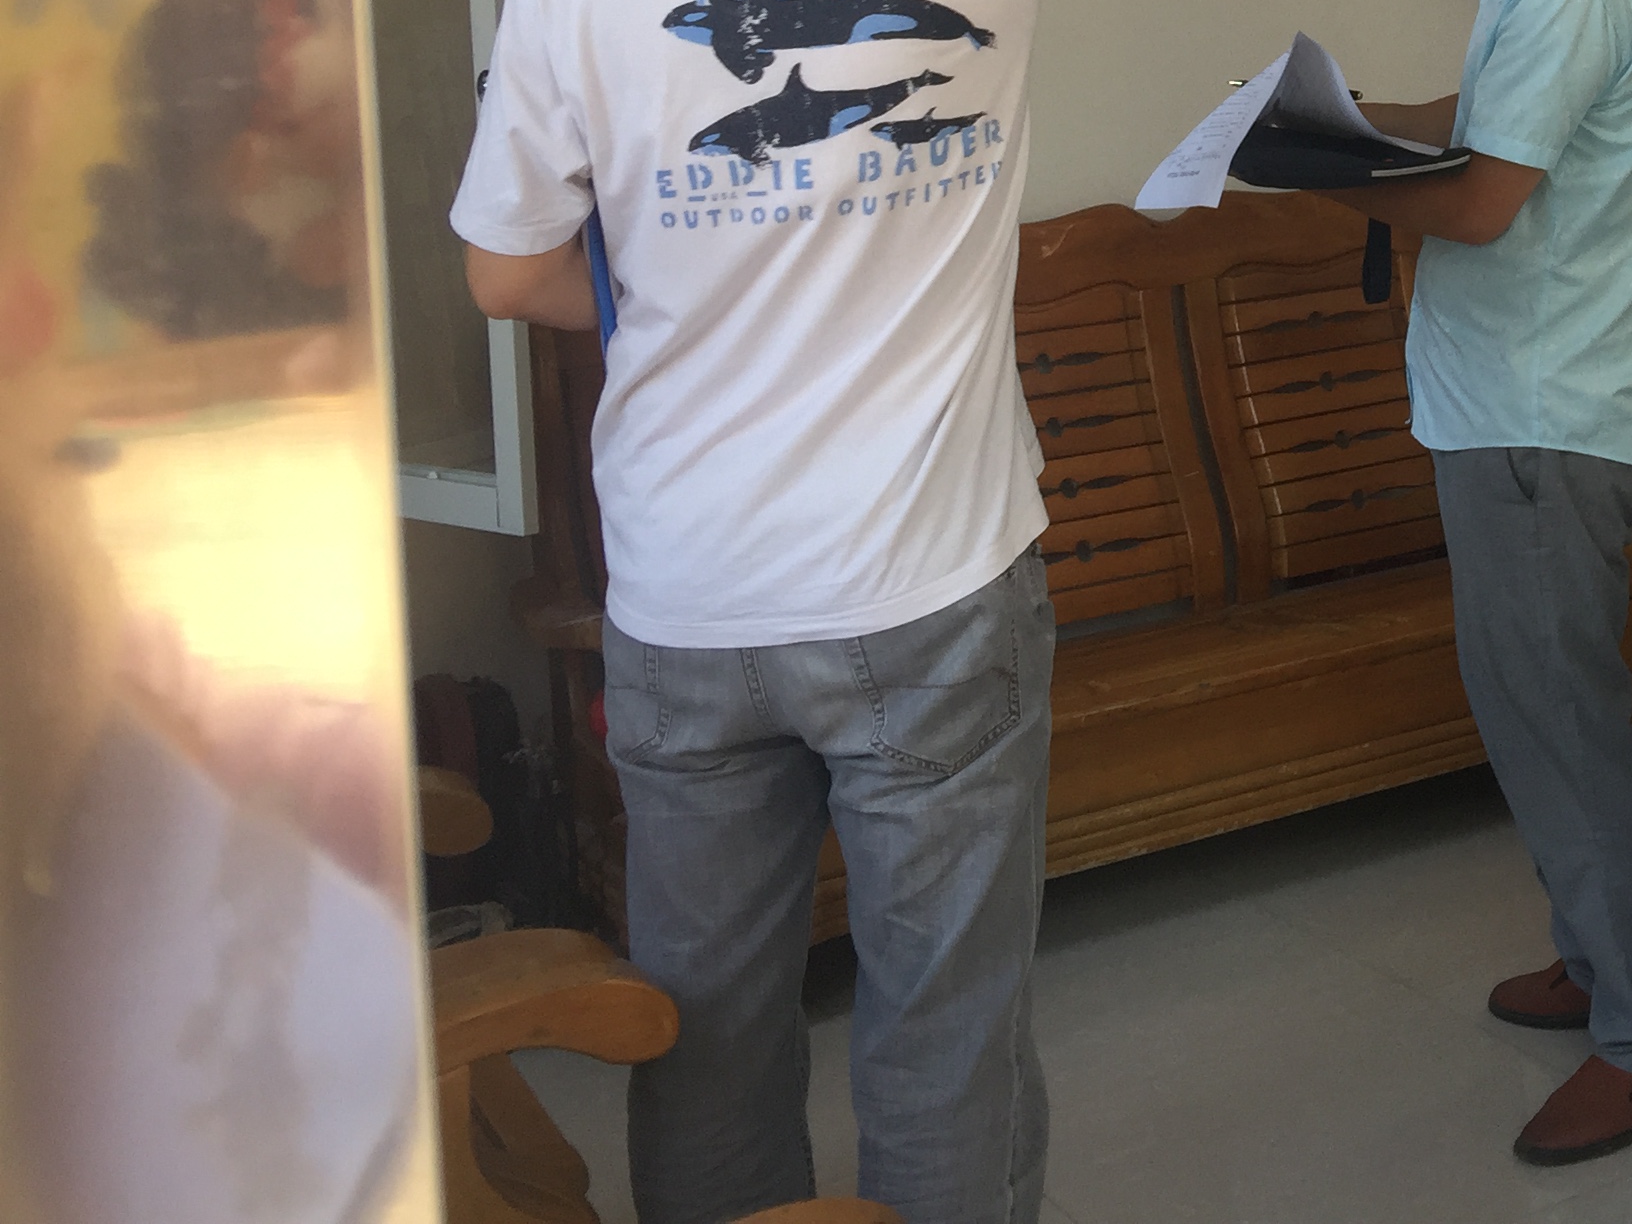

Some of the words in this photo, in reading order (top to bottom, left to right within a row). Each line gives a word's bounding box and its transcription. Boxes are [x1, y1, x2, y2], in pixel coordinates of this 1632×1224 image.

[655, 158, 815, 199] EDDIE
[858, 118, 1005, 184] BAUER
[660, 204, 815, 230] OUTDOOR
